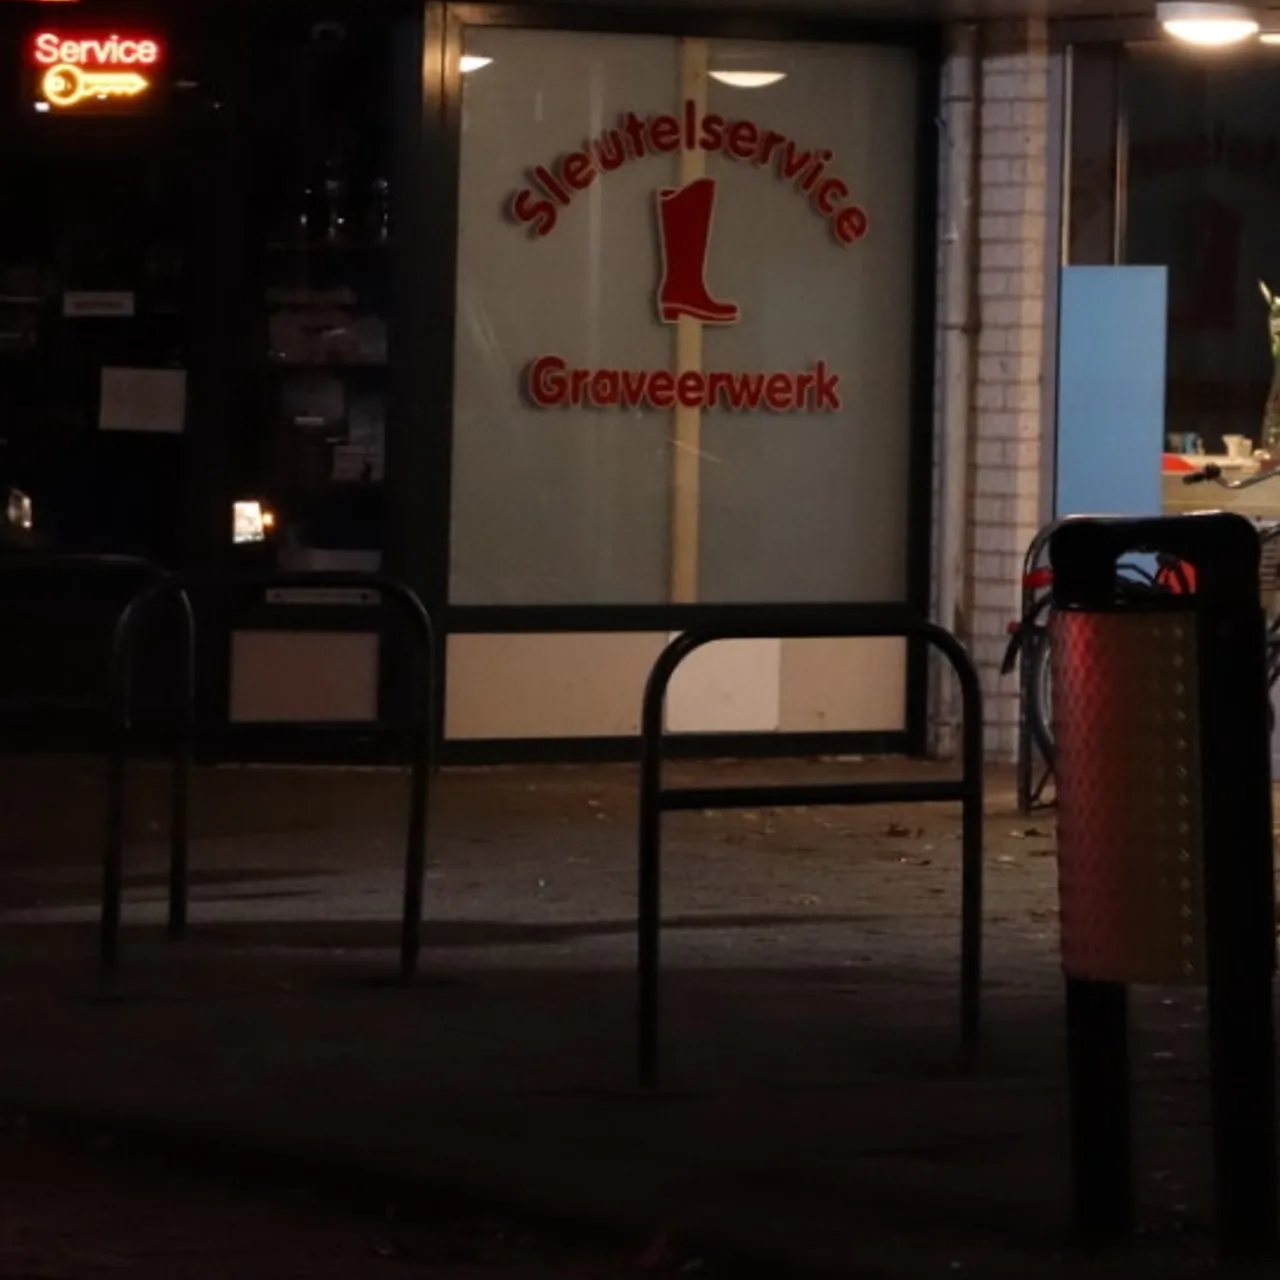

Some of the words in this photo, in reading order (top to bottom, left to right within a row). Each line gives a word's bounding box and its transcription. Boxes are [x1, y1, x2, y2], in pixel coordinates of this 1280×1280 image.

[35, 33, 158, 64] Service
[513, 99, 868, 244] Sleutelservice
[531, 356, 841, 409] Graveerwerk
